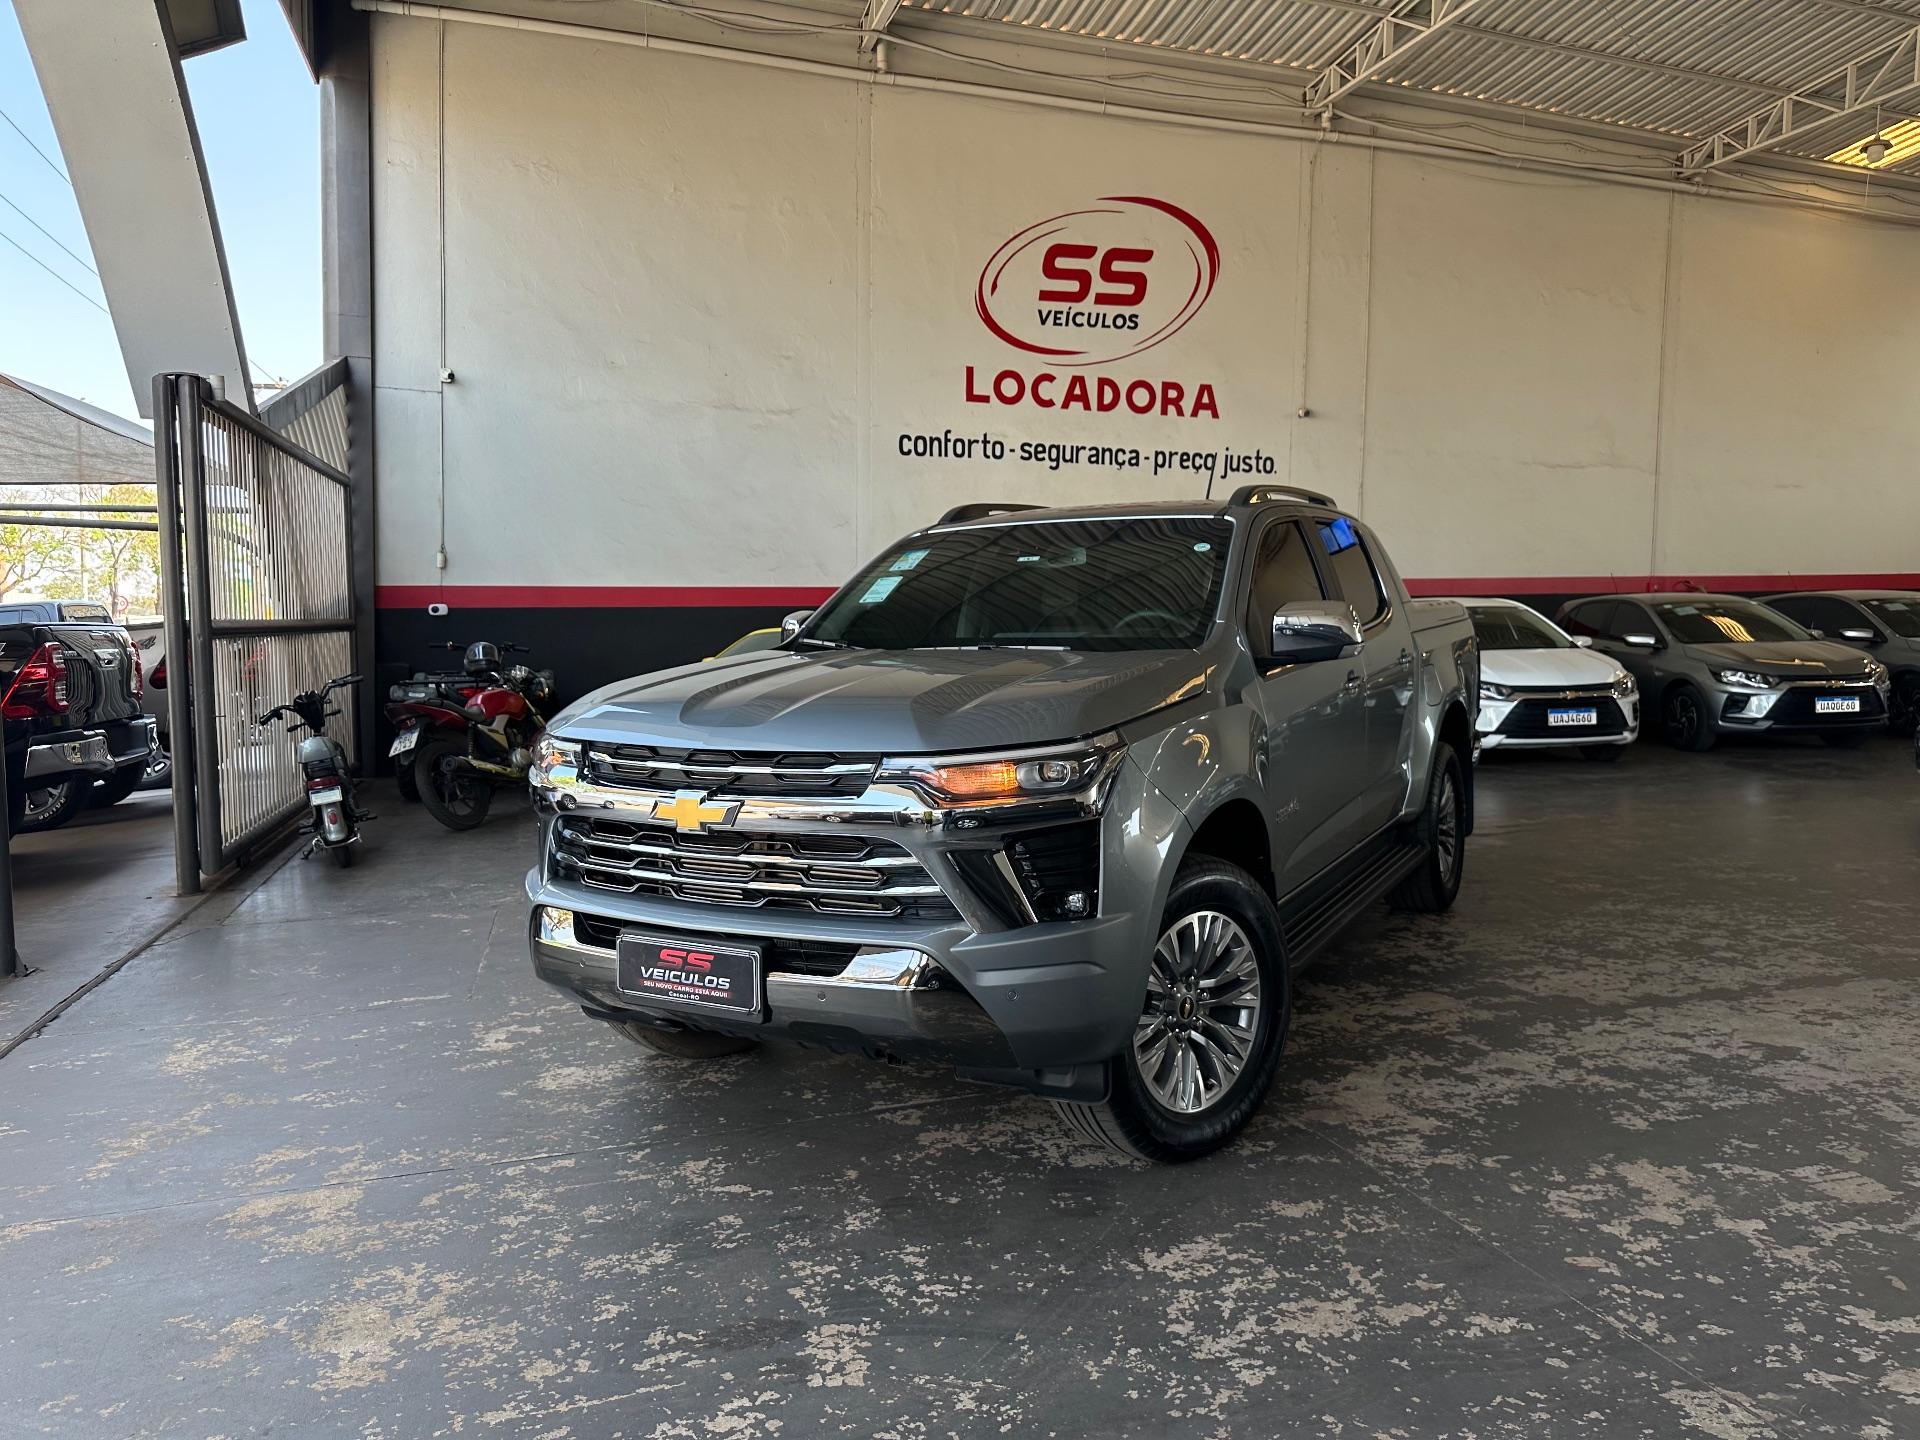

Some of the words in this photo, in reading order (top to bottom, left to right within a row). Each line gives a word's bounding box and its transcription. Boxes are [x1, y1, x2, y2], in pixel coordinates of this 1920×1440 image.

[1038, 243, 1154, 307] SS
[1037, 306, 1140, 330] VEÍCULOS
[965, 366, 1220, 419] LOCADORA
[1220, 447, 1278, 479] justo.
[657, 949, 715, 973] SS
[640, 966, 731, 990] VEICULOS
[673, 985, 694, 993] CARRO
